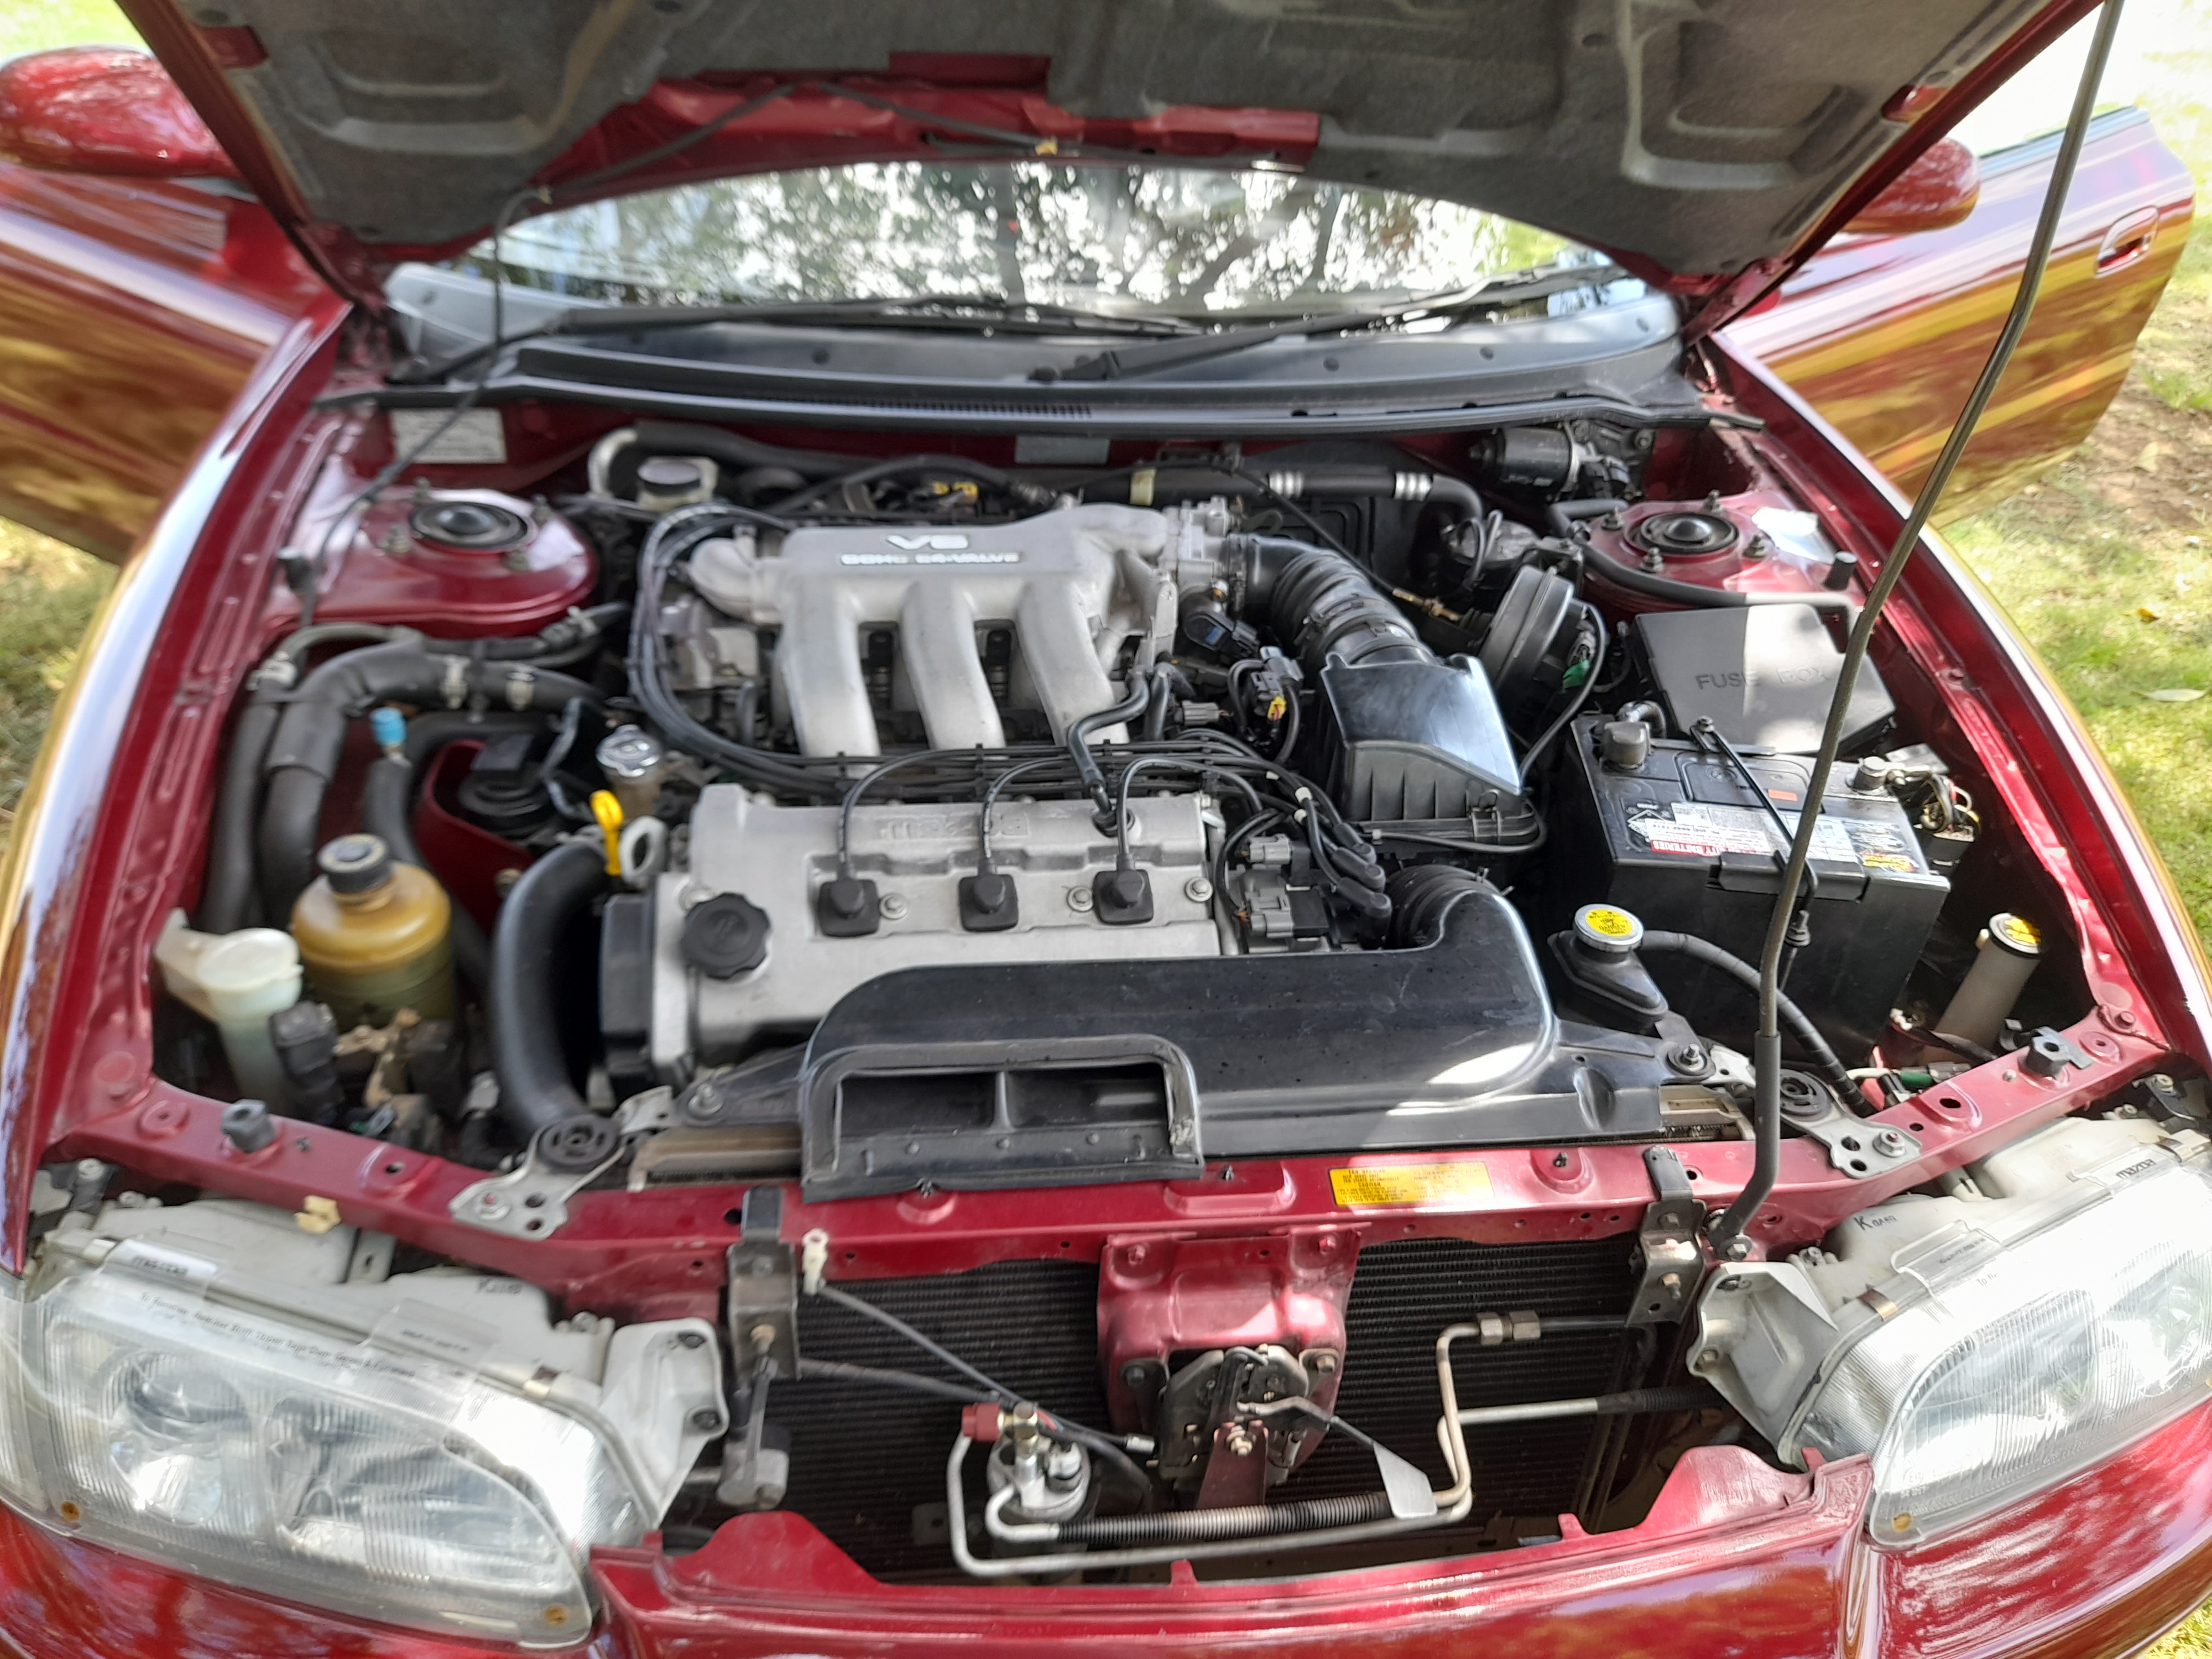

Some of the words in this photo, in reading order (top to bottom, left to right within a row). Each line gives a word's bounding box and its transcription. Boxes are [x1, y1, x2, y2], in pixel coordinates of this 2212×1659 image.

[1694, 671, 1762, 691] FUSE
[1776, 666, 1834, 685] BOX
[1652, 840, 1704, 855] BATTERIES
